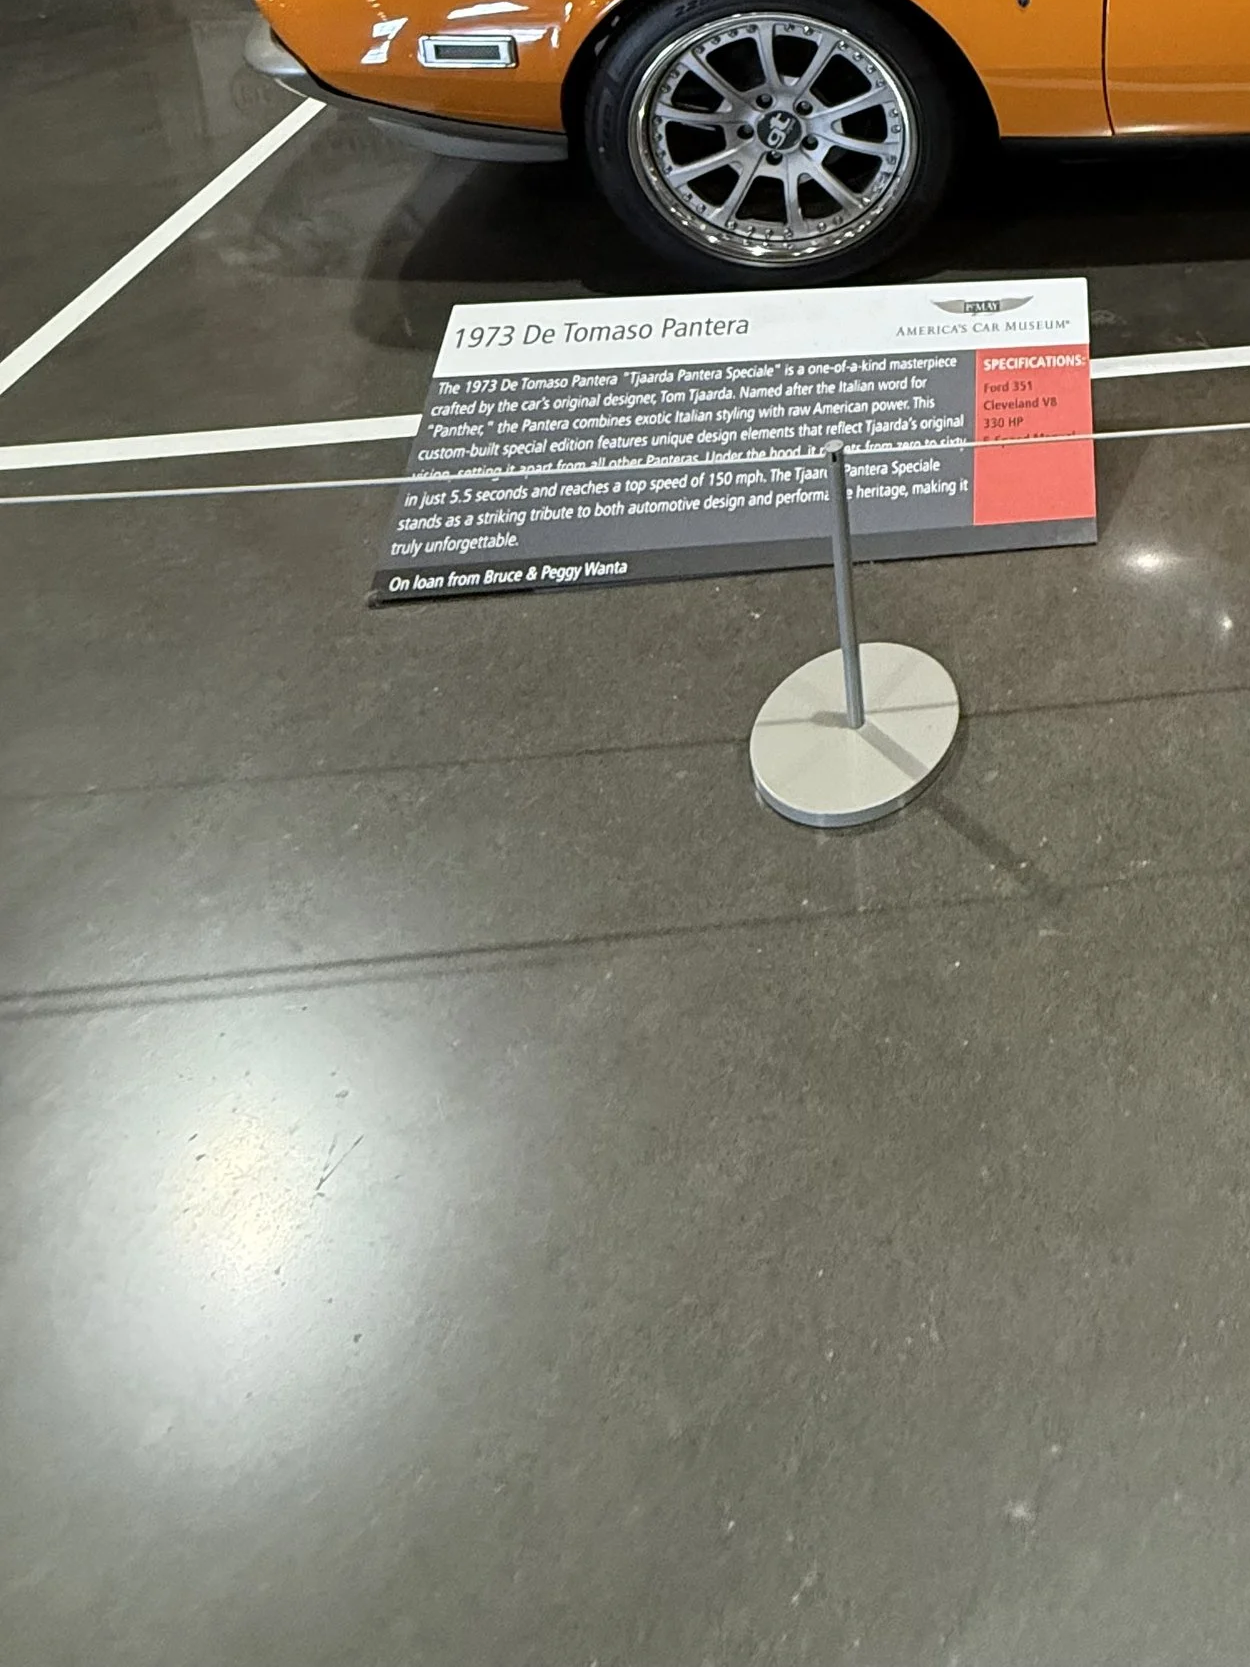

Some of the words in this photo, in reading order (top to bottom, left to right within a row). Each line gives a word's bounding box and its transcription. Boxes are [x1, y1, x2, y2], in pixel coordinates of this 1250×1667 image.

[455, 324, 516, 349] 1973
[522, 323, 556, 345] De
[563, 321, 653, 343] Tomaso
[660, 317, 749, 338] Pantera
[896, 324, 968, 337] AMERICA'S
[972, 322, 1000, 333] CAR
[983, 354, 1087, 372] SPECIFICATIONS:
[438, 381, 461, 395] The
[465, 378, 498, 393] 1973
[499, 378, 519, 391] De
[520, 376, 569, 390] Tomaso
[570, 374, 618, 387] Pantera
[676, 368, 723, 382] Pantera
[783, 363, 794, 376] is
[796, 365, 805, 375] a
[807, 358, 887, 375] one-of-a-kind
[888, 355, 957, 371] masterpiece
[984, 381, 1009, 393] Ford
[1012, 380, 1032, 391] 351
[983, 397, 1039, 410] Cleveland
[1042, 397, 1057, 406] V8
[984, 417, 1004, 428] 330
[1008, 416, 1023, 427] HP
[388, 576, 410, 592] On
[411, 574, 444, 590] loan
[446, 571, 481, 587] from
[482, 569, 523, 584] Bruce
[525, 566, 537, 581] &
[540, 565, 583, 582] Peggy
[583, 561, 628, 576] Wanta
